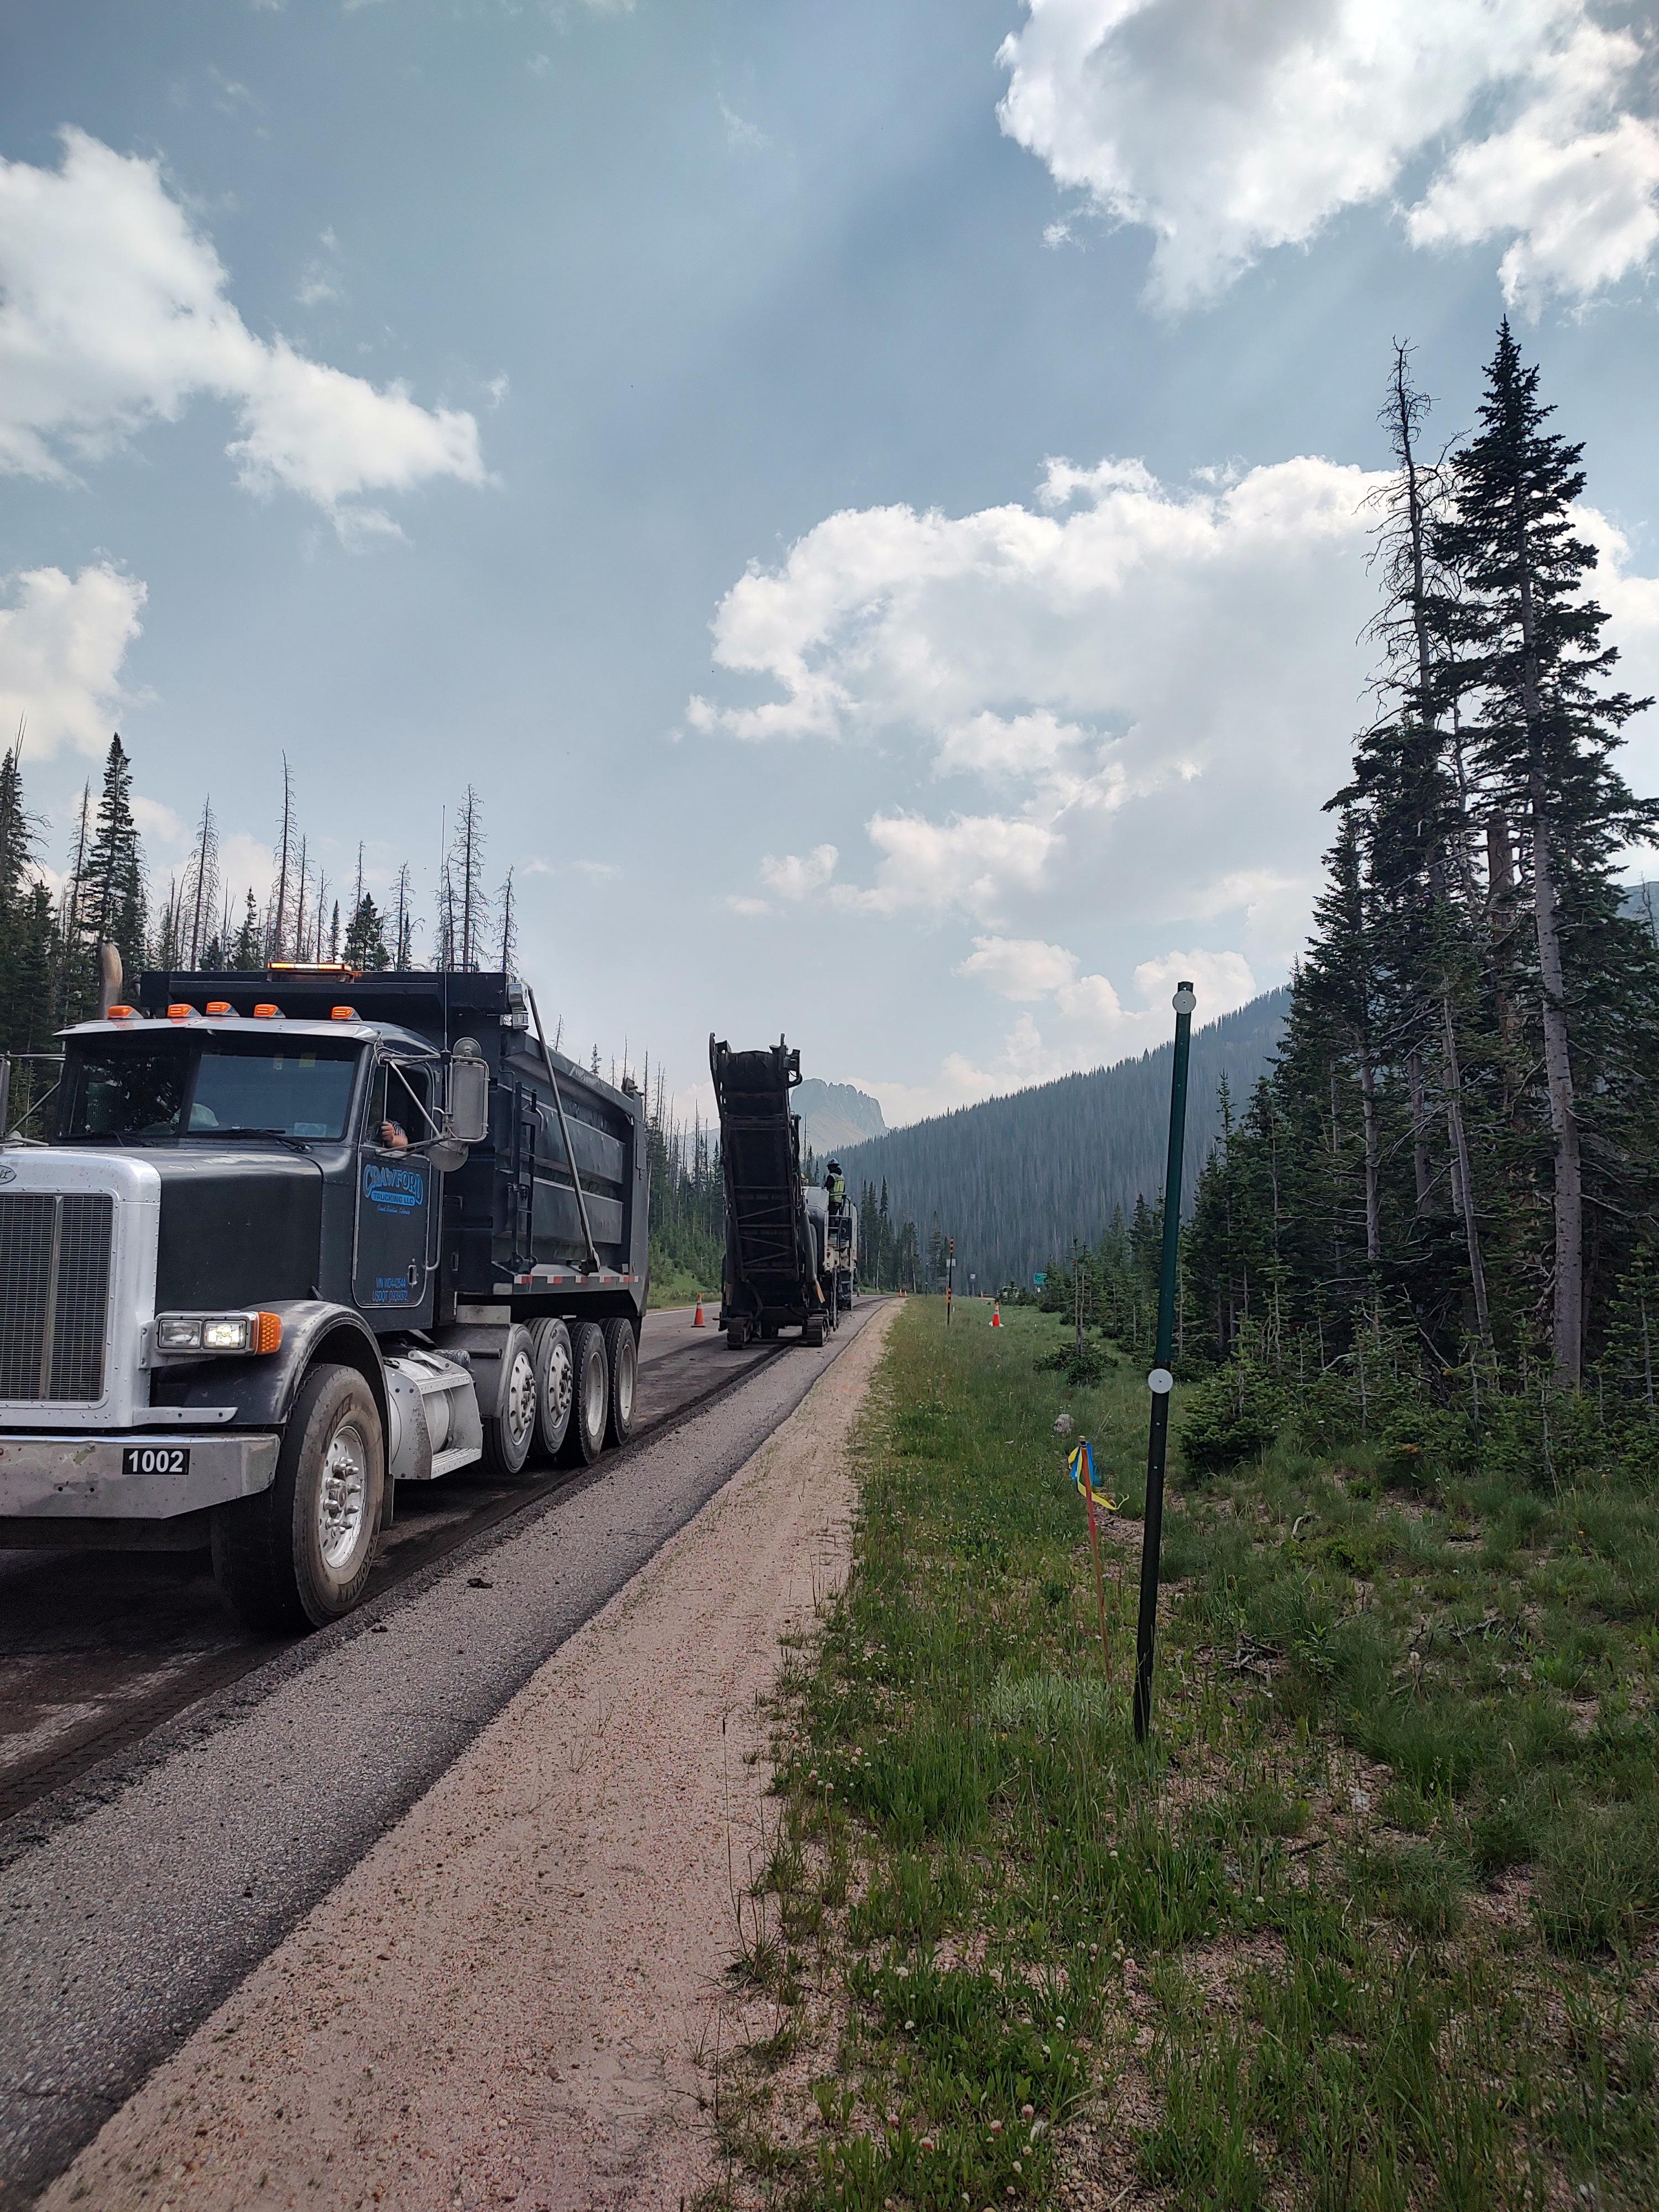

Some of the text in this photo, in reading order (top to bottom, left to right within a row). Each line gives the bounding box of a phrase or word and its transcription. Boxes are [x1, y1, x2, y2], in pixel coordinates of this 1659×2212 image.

[363, 1164, 423, 1206] CRAWFORD
[374, 1193, 414, 1204] TRUCKING LLC
[129, 1450, 184, 1472] 1002
